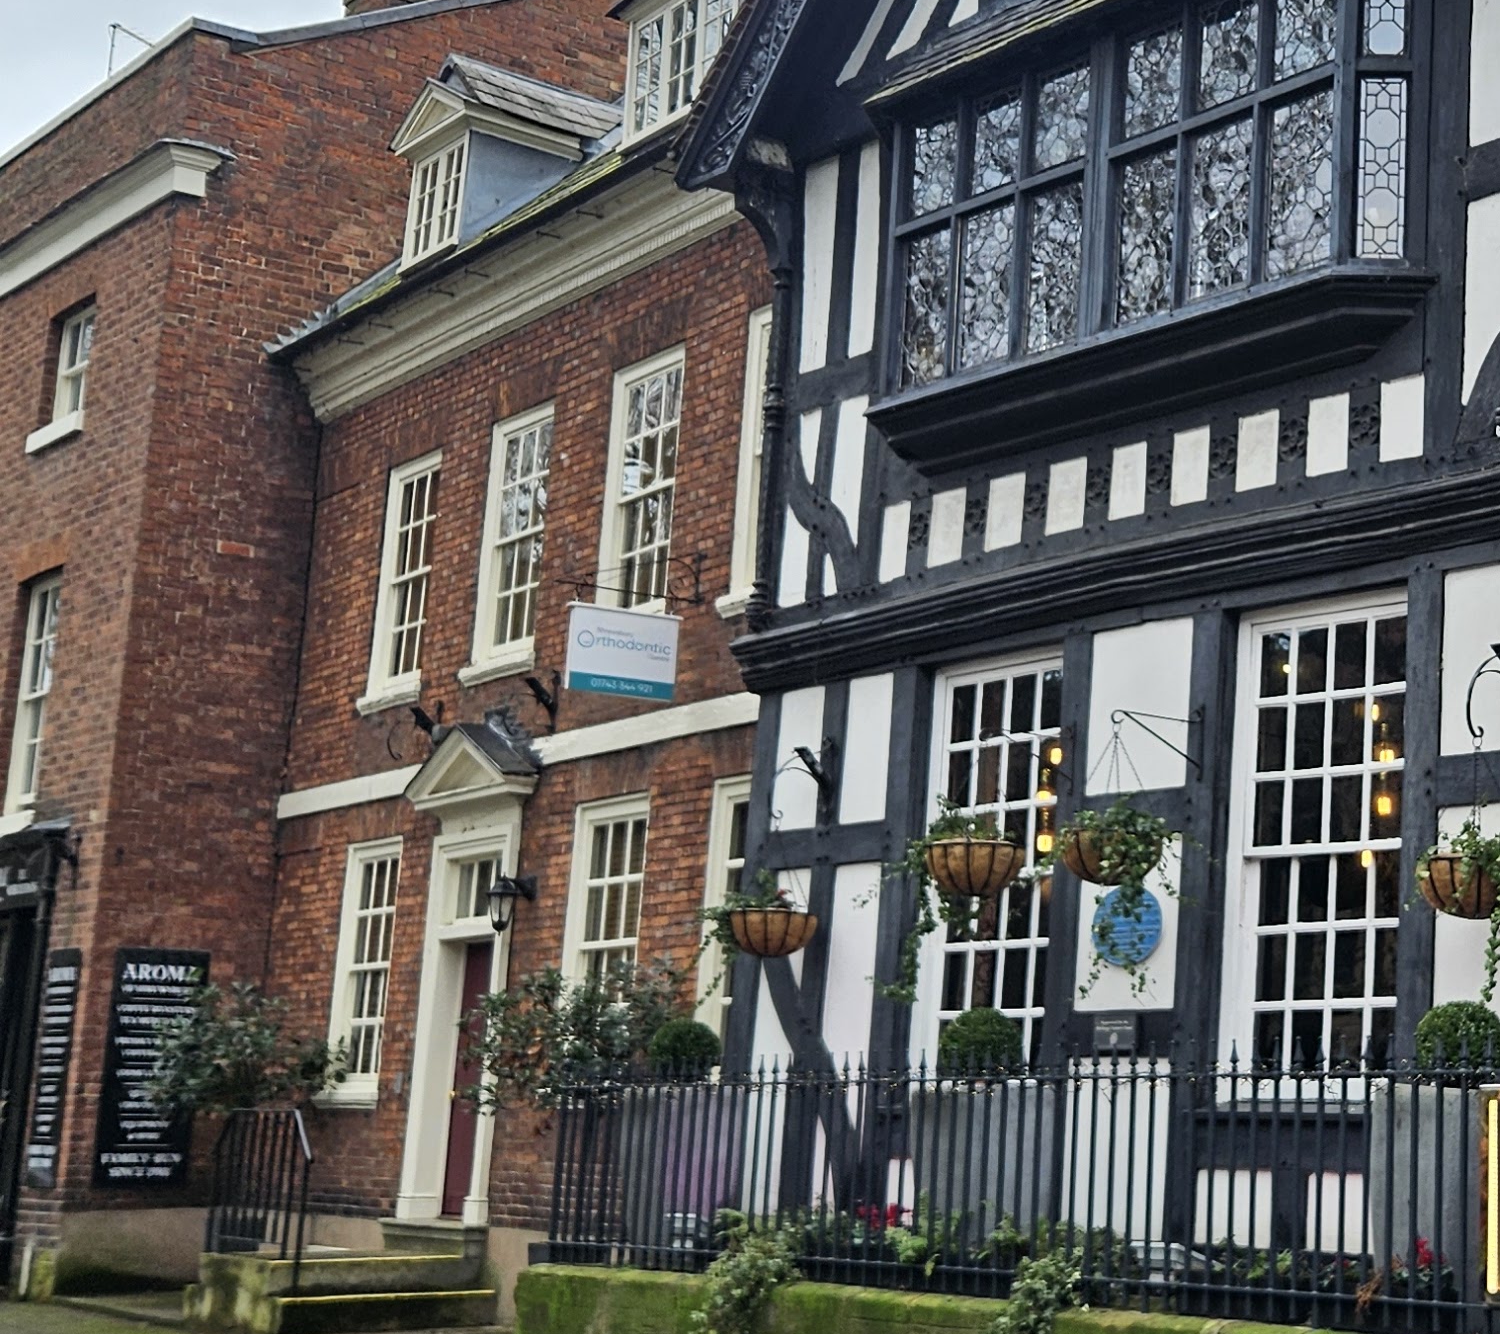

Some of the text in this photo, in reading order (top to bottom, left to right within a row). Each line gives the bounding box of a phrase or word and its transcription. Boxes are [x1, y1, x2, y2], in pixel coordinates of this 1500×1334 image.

[577, 630, 671, 655] Orthodontic
[591, 678, 653, 693] 01743 344 921
